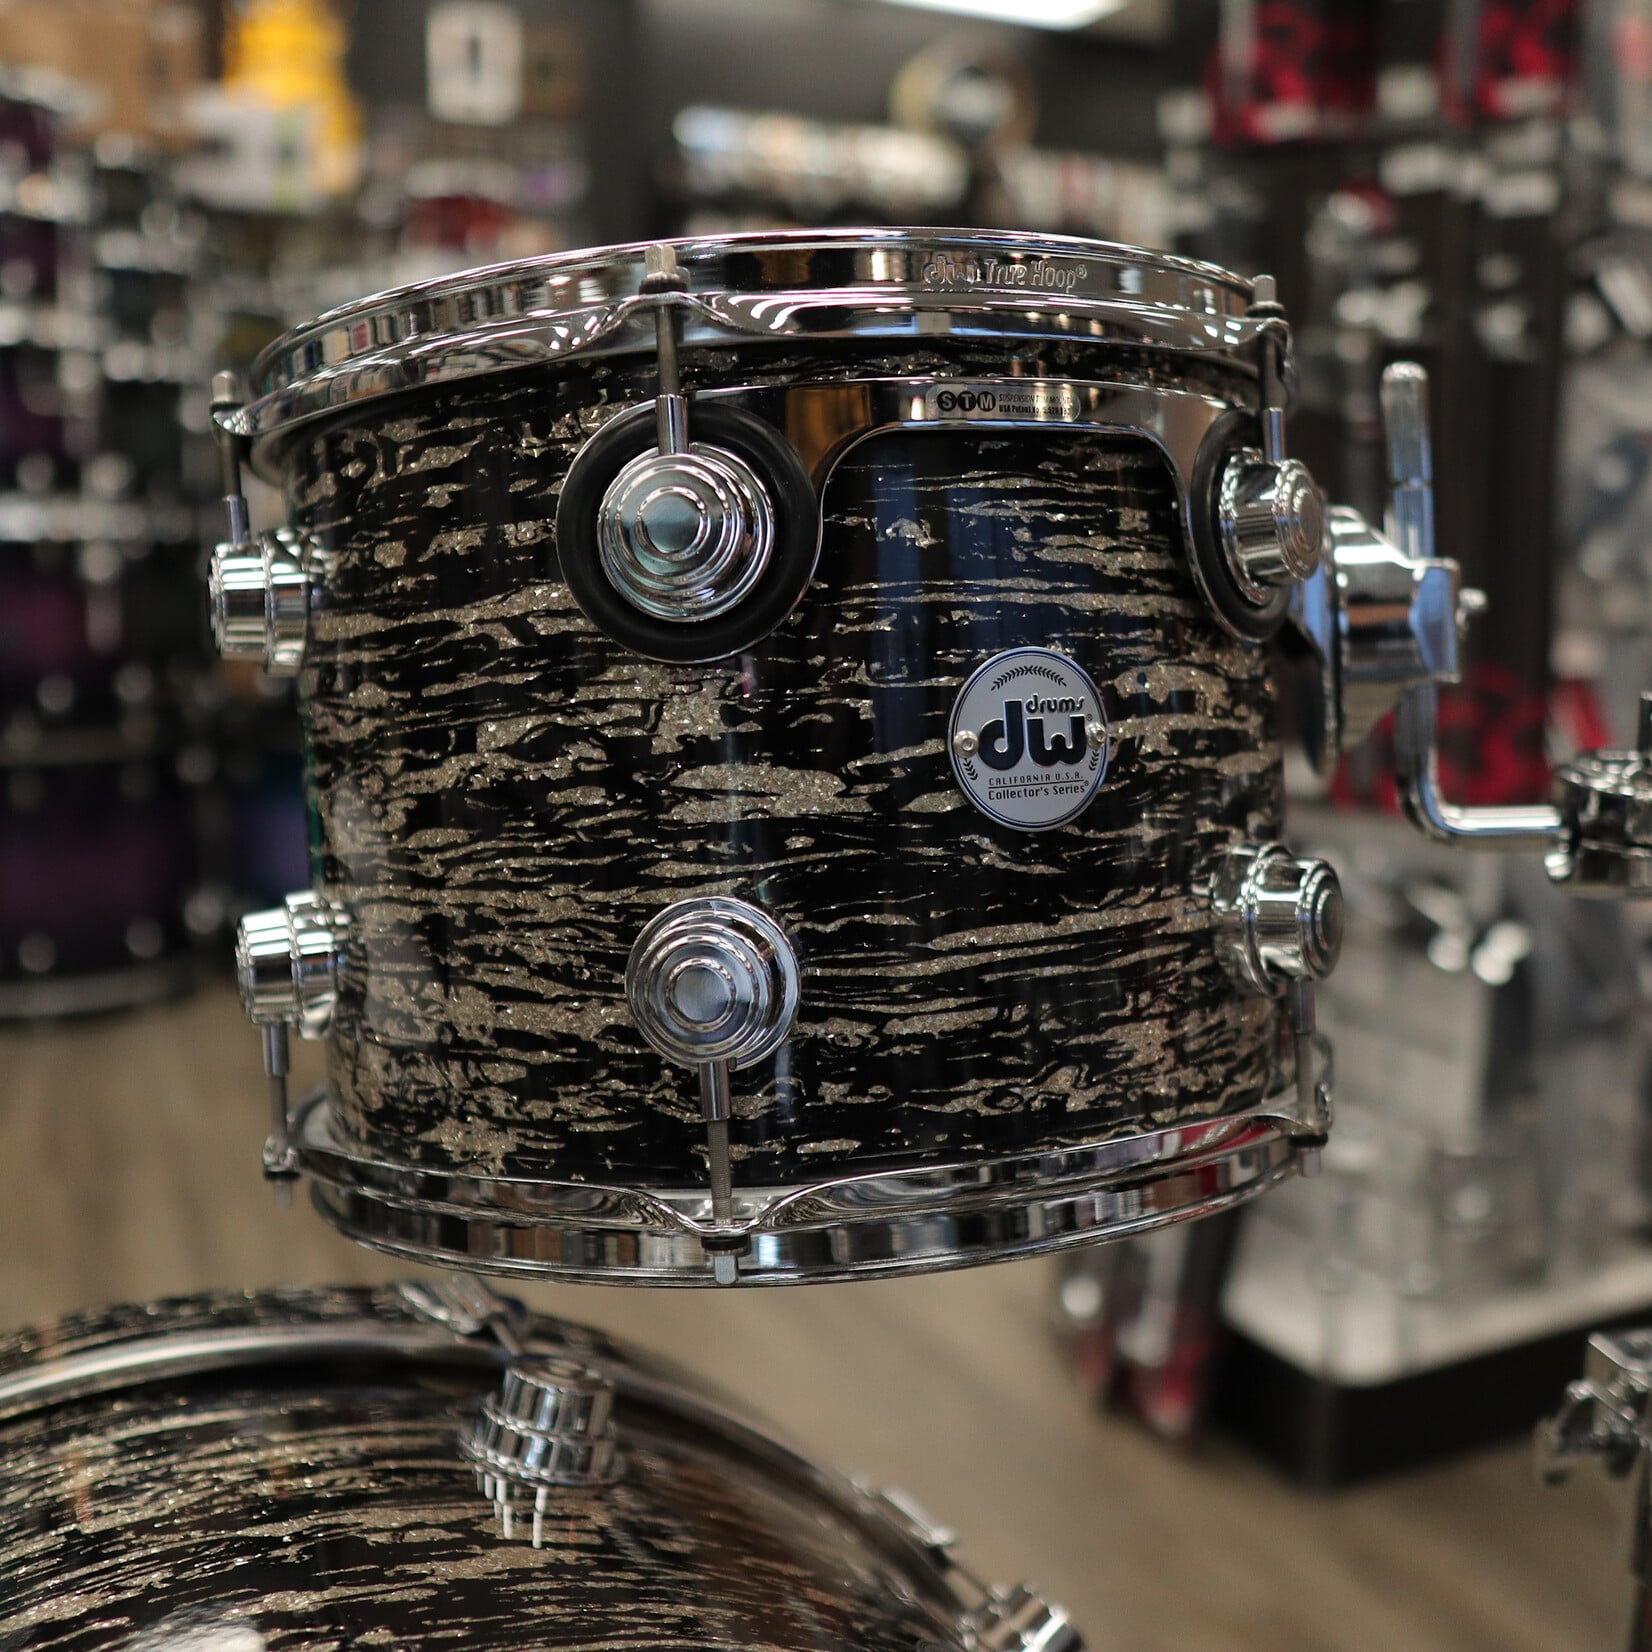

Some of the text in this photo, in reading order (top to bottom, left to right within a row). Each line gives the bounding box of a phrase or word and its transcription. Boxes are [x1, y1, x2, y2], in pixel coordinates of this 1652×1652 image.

[984, 257, 1028, 286] True
[998, 404, 1011, 413] USA
[1025, 693, 1085, 713] drums
[988, 771, 1084, 786] CALIFORNIA U.S.A.
[988, 786, 1049, 801] Collector's
